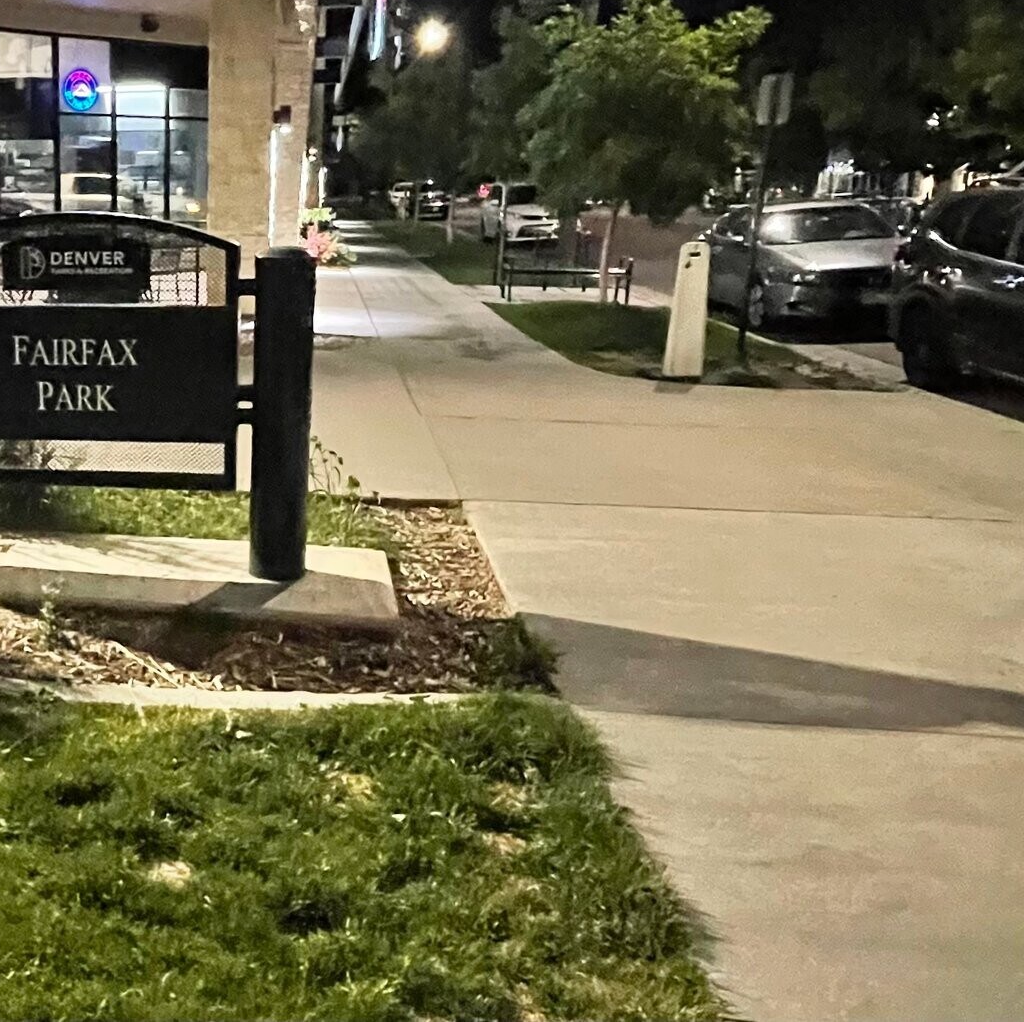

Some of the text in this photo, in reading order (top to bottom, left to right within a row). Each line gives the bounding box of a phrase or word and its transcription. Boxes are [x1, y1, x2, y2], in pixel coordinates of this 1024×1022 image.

[50, 251, 125, 266] DENVER
[12, 335, 138, 366] FAIRFAX
[36, 380, 118, 412] PARK
